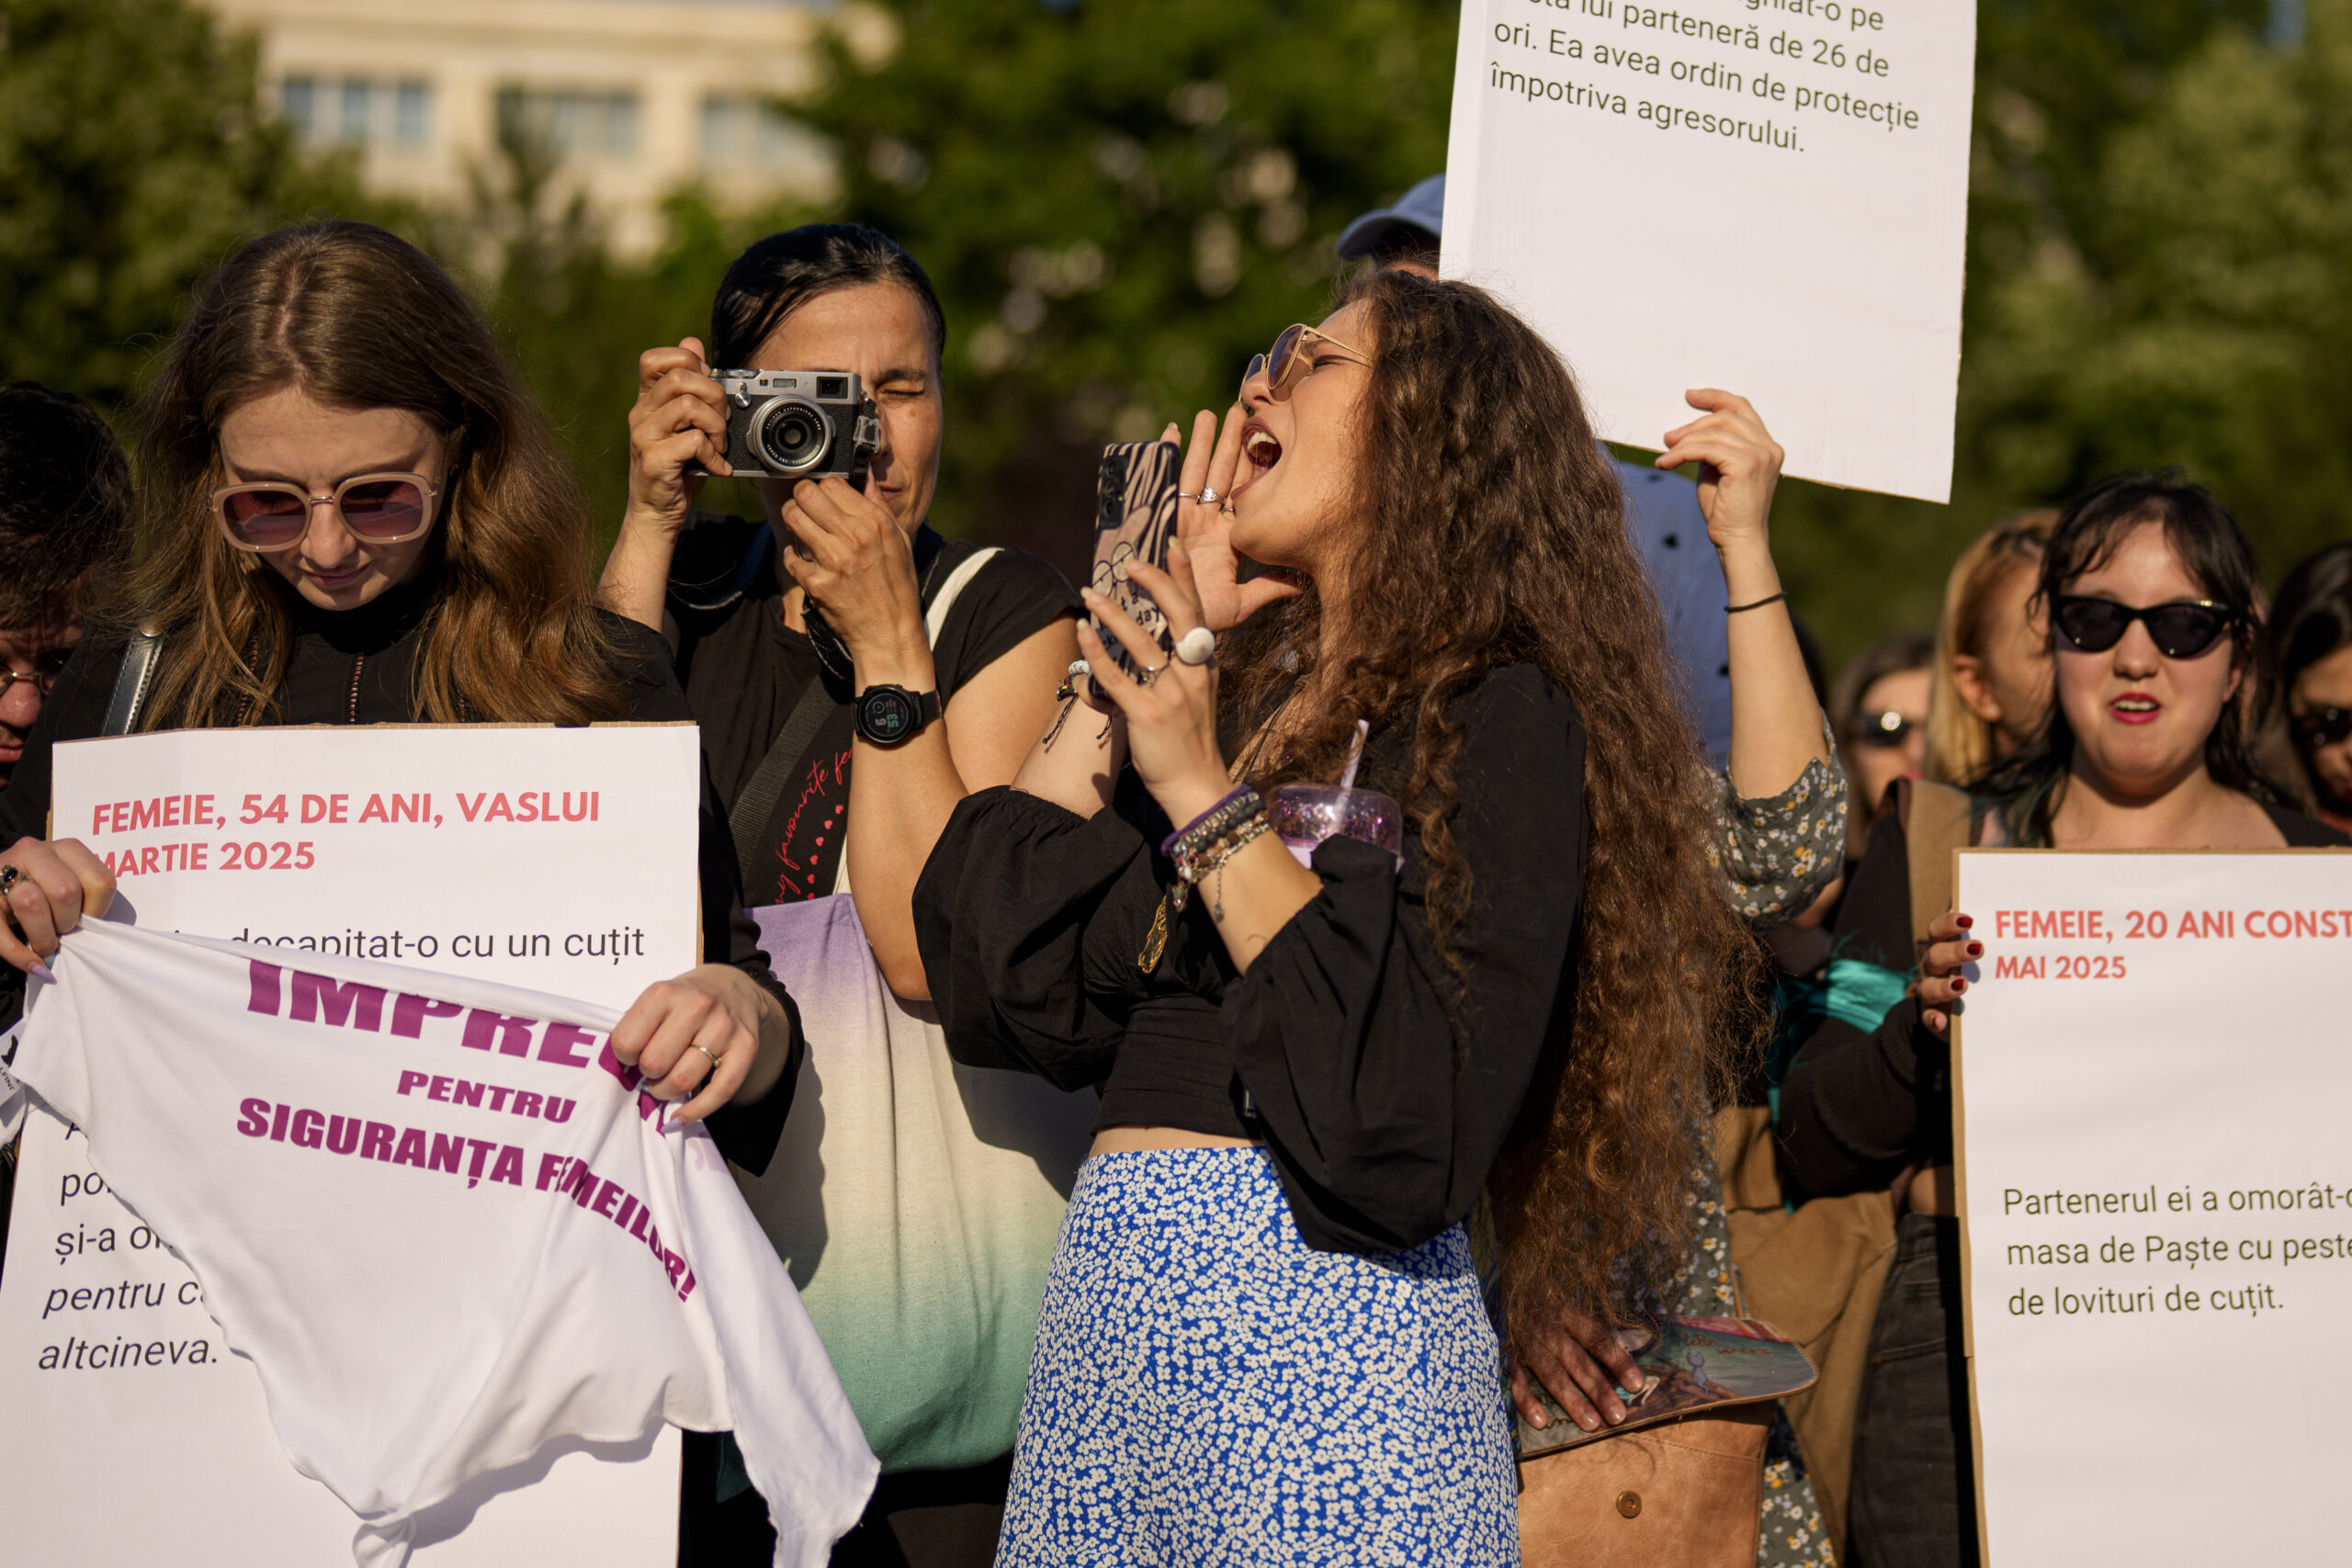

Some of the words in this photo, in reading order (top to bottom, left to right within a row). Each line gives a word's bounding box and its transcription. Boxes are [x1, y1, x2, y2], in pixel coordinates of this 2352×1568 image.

[1851, 7, 1883, 31] pe
[1623, 1, 1760, 52] parteneră
[1770, 30, 1803, 59] de
[1813, 39, 1846, 68] 26
[1856, 49, 1889, 77] de
[1495, 23, 1536, 50] ori.
[1550, 29, 1582, 59] Ea
[1594, 45, 1659, 75] avea
[1671, 61, 1742, 92] ordin
[1752, 73, 1785, 101] de
[1792, 86, 1918, 134] protecție
[1491, 58, 1629, 115] împotriva
[1638, 97, 1807, 152] agresorului.
[93, 795, 226, 836] FEMEIE,
[239, 795, 288, 824] 54
[300, 794, 348, 823] DE
[358, 794, 443, 829] ANI,
[456, 792, 599, 822] VASLUI
[219, 841, 314, 870] 2025
[452, 935, 493, 957] cu
[509, 934, 549, 957] un
[565, 926, 644, 965] cuțit
[1996, 910, 2113, 943] FEMEIE,
[2125, 910, 2167, 939] 20
[2177, 911, 2234, 938] ANI
[1996, 956, 2045, 979] MAI
[2055, 955, 2126, 979] 2025
[397, 1069, 577, 1123] PENTRU
[236, 1098, 524, 1189] SIGURANȚA
[2005, 1185, 2156, 1215] Partenerul
[2167, 1185, 2190, 1212] ei
[2203, 1191, 2218, 1211] a
[55, 1224, 115, 1265] și-a
[2007, 1244, 2088, 1265] masa
[2100, 1235, 2134, 1263] de
[2146, 1235, 2229, 1269] Paște
[2239, 1240, 2271, 1260] cu
[42, 1280, 165, 1320] pentru
[2008, 1287, 2043, 1315] de
[2055, 1286, 2154, 1314] lovituri
[2165, 1284, 2200, 1312] de
[2211, 1283, 2283, 1317] cuțit.
[39, 1336, 217, 1370] altcineva.
